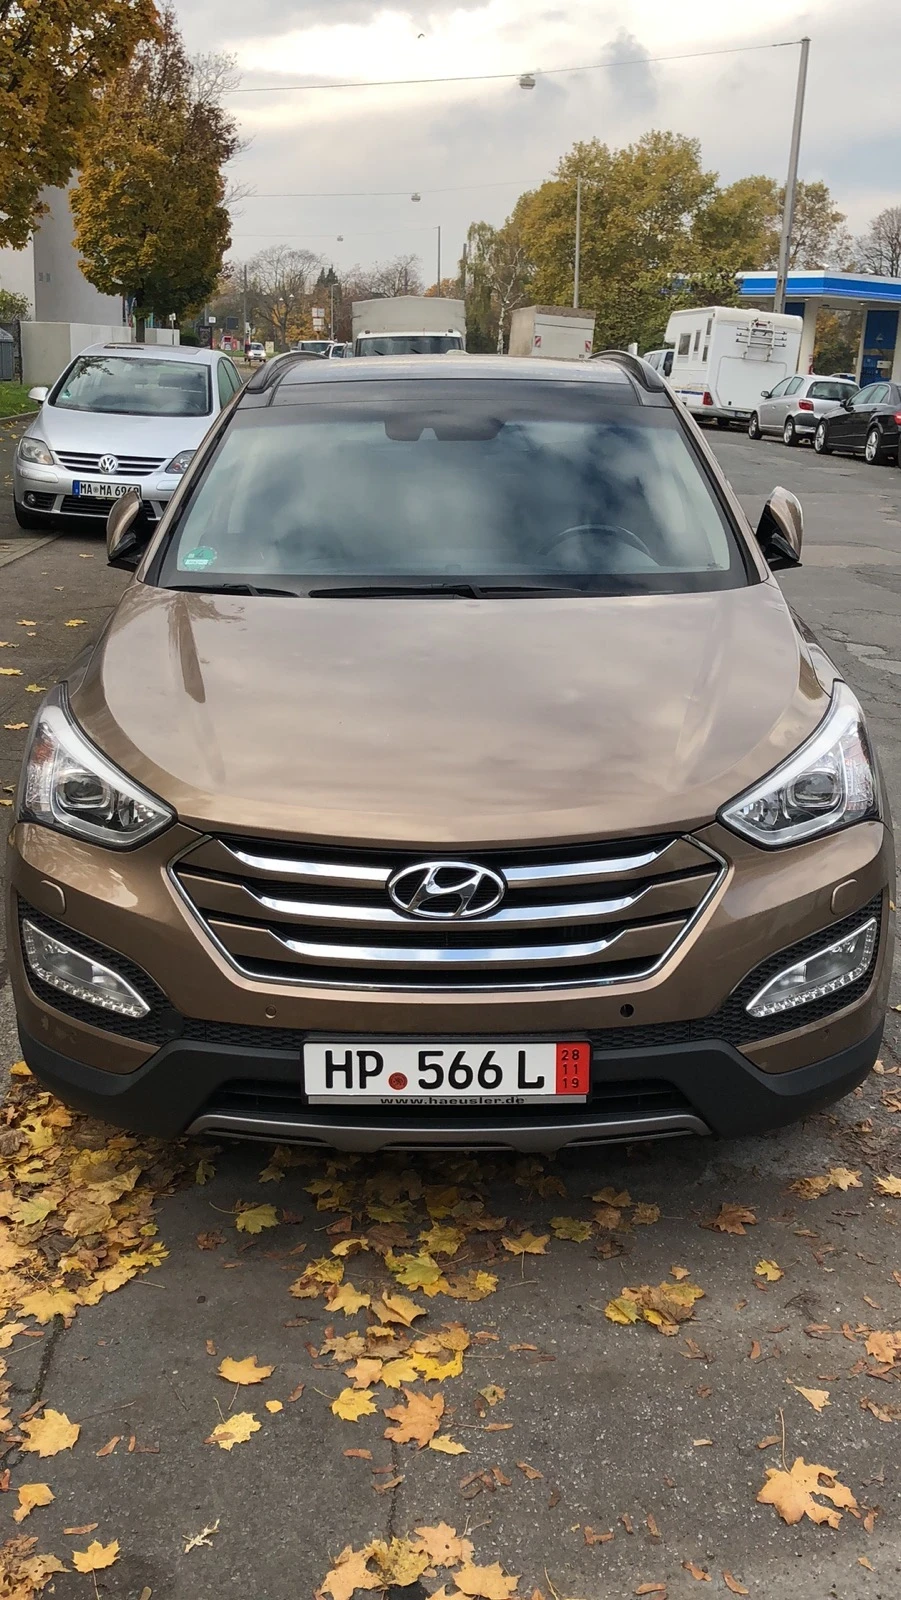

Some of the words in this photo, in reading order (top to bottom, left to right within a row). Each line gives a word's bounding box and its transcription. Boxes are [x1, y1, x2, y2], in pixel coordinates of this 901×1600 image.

[80, 483, 93, 495] MA
[100, 484, 112, 496] MA
[561, 1049, 580, 1060] 28
[325, 1050, 384, 1089] HP
[418, 1050, 503, 1089] 566
[517, 1050, 545, 1089] L
[562, 1063, 578, 1075] 11
[562, 1077, 580, 1089] 19
[380, 1096, 525, 1105] www.haeusler.de
